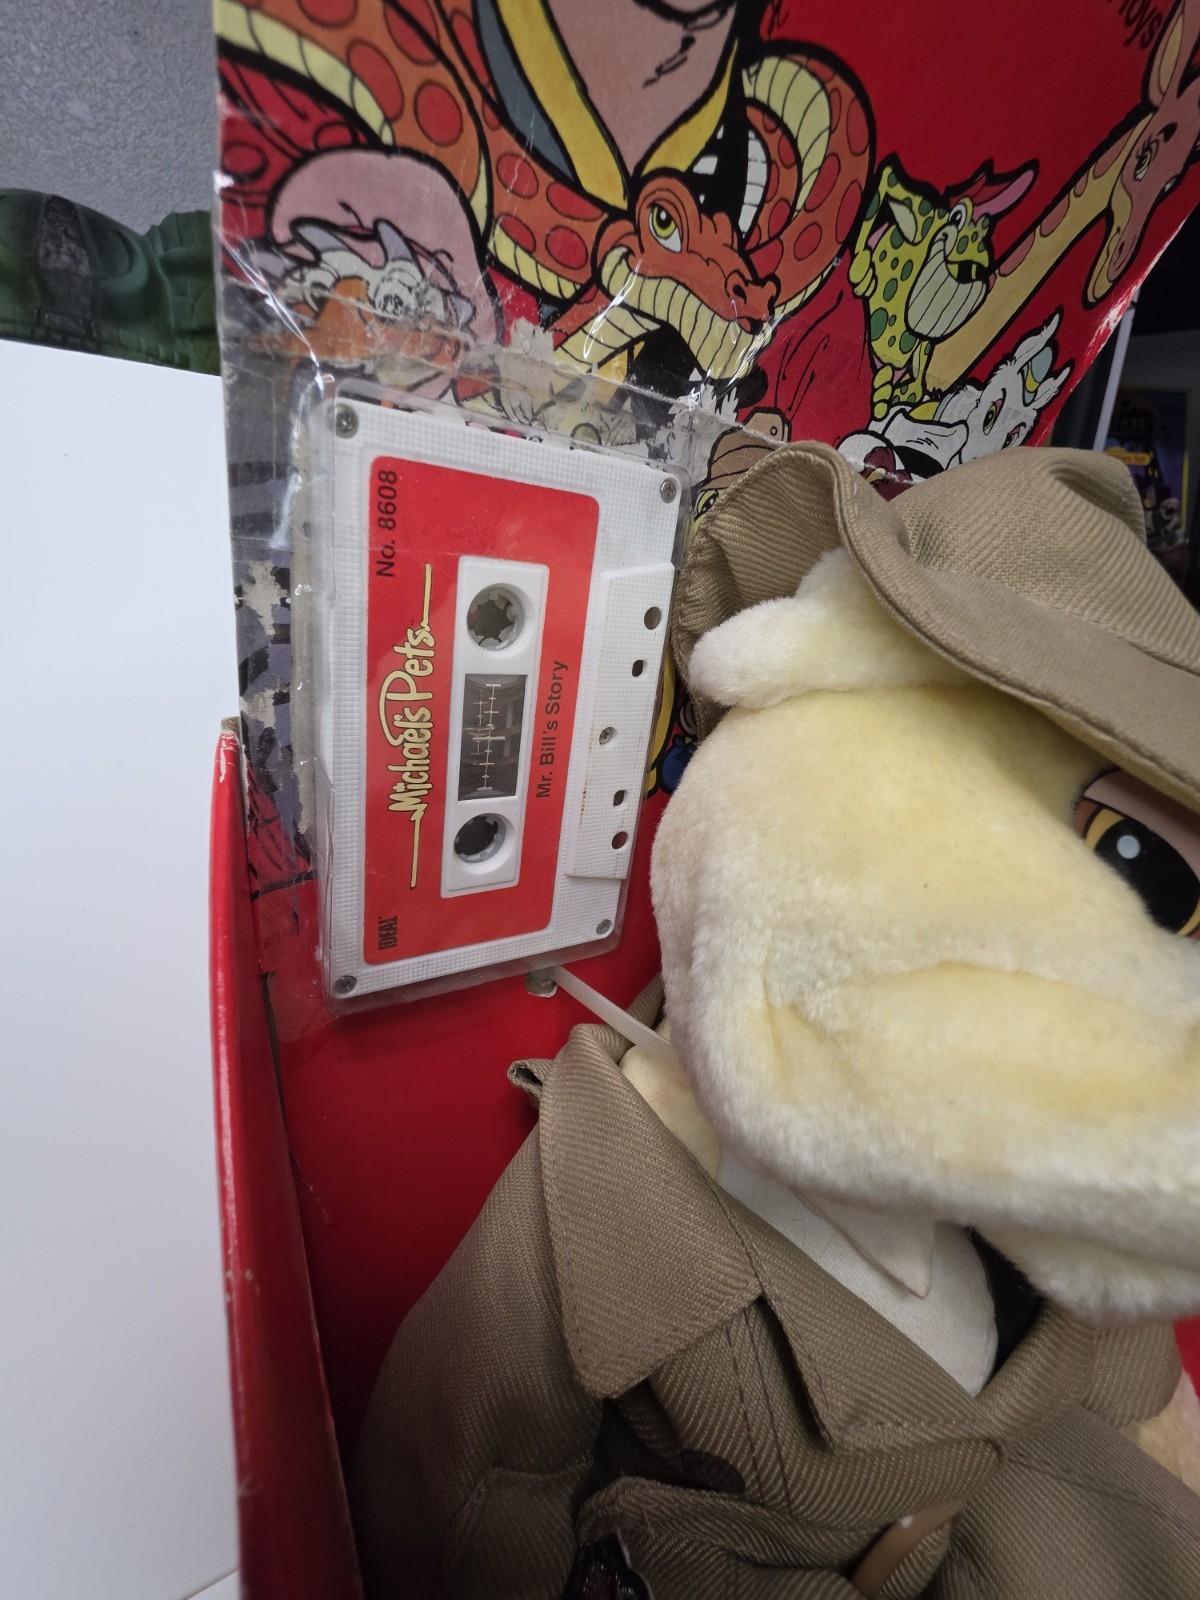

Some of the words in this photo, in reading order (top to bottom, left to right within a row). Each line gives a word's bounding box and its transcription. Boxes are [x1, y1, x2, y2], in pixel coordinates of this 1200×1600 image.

[377, 469, 397, 531] 8608
[376, 540, 396, 577] No.
[378, 628, 436, 747] Pets
[545, 660, 568, 715] Story
[387, 706, 433, 813] Michael's
[539, 720, 558, 766] Bill's
[536, 772, 552, 798] Mr.
